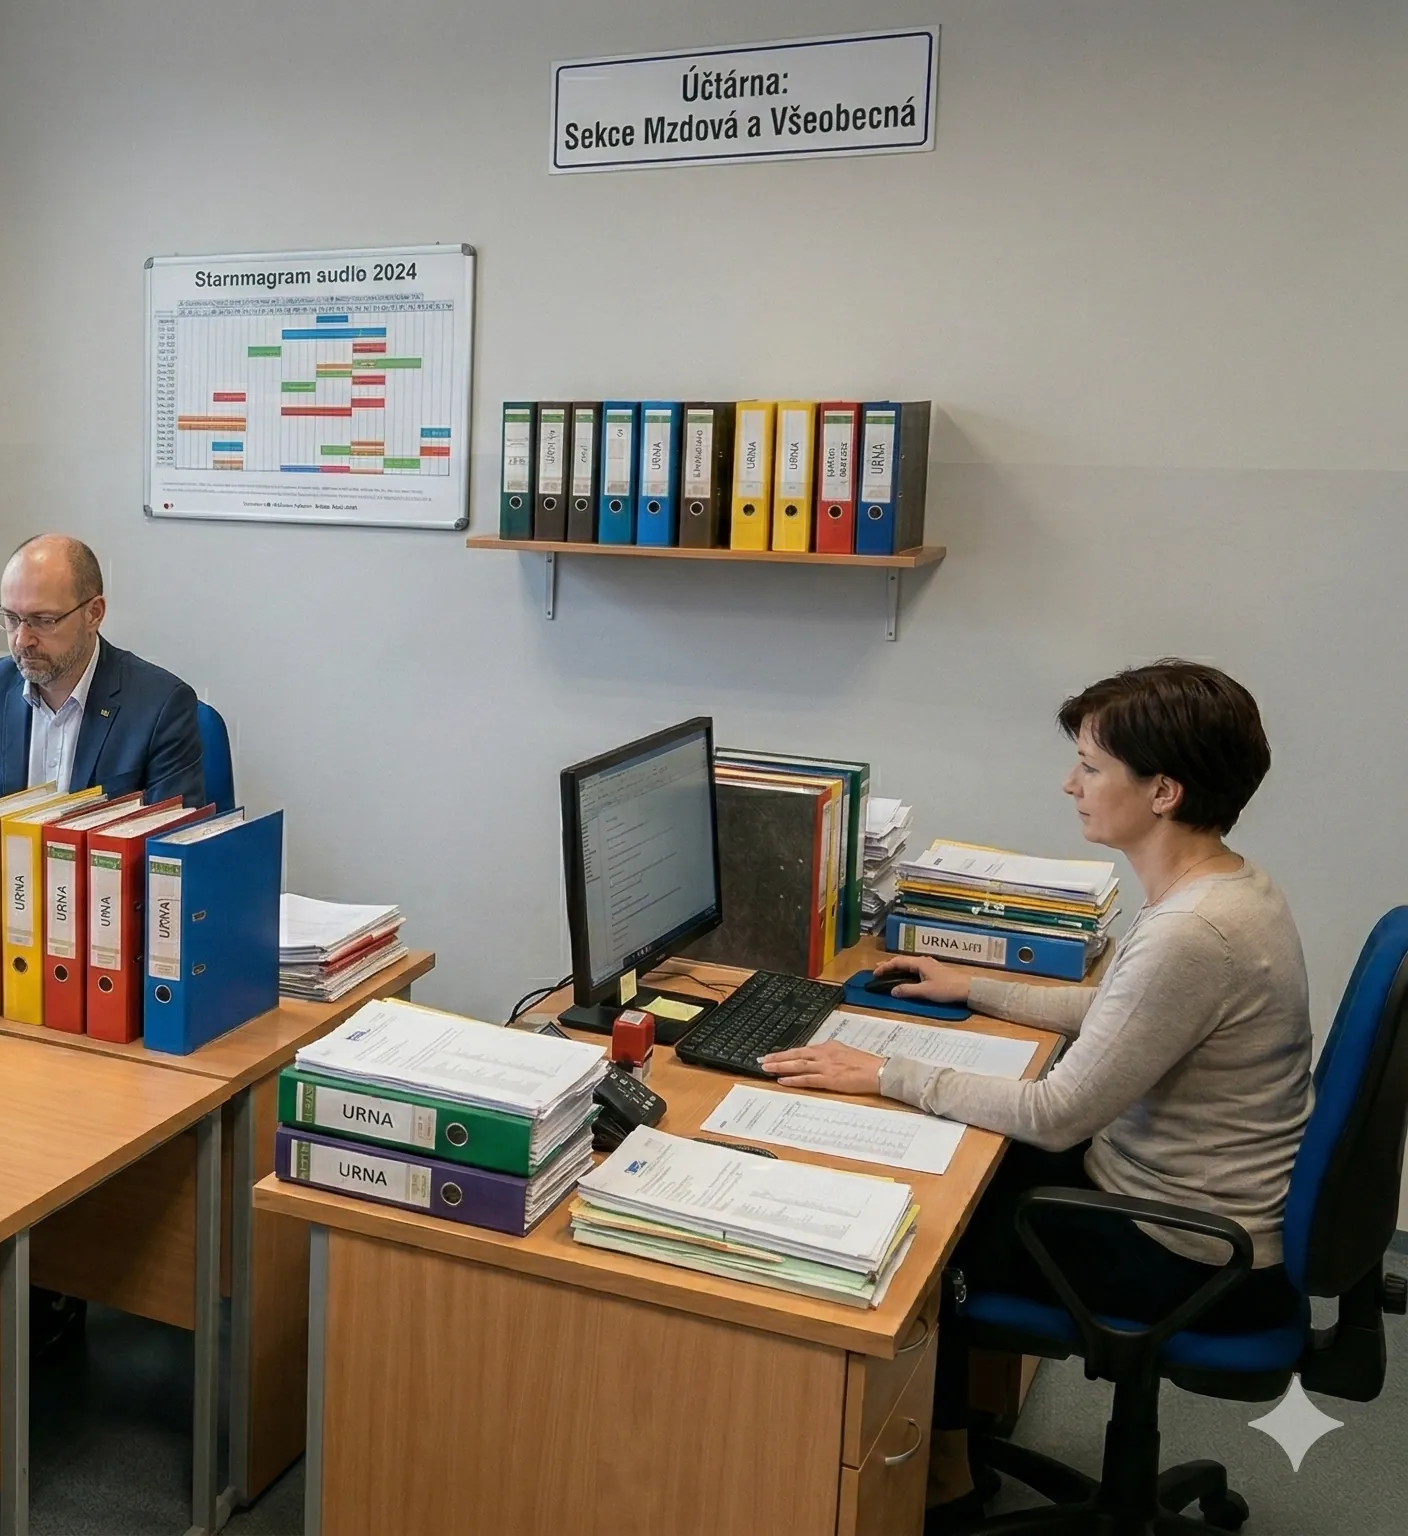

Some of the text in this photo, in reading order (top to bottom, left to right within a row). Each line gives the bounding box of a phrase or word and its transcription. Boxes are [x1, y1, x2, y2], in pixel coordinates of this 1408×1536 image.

[682, 65, 789, 102] Účtárna:
[564, 95, 916, 150] Sekce Mzdová a Všeobecná
[194, 270, 311, 289] Starnmagram
[372, 262, 417, 281] 2024
[15, 875, 25, 911] URNA
[56, 885, 67, 922] URNA
[922, 935, 959, 949] URNA
[342, 1103, 394, 1128] URNA
[339, 1162, 387, 1186] URNA
